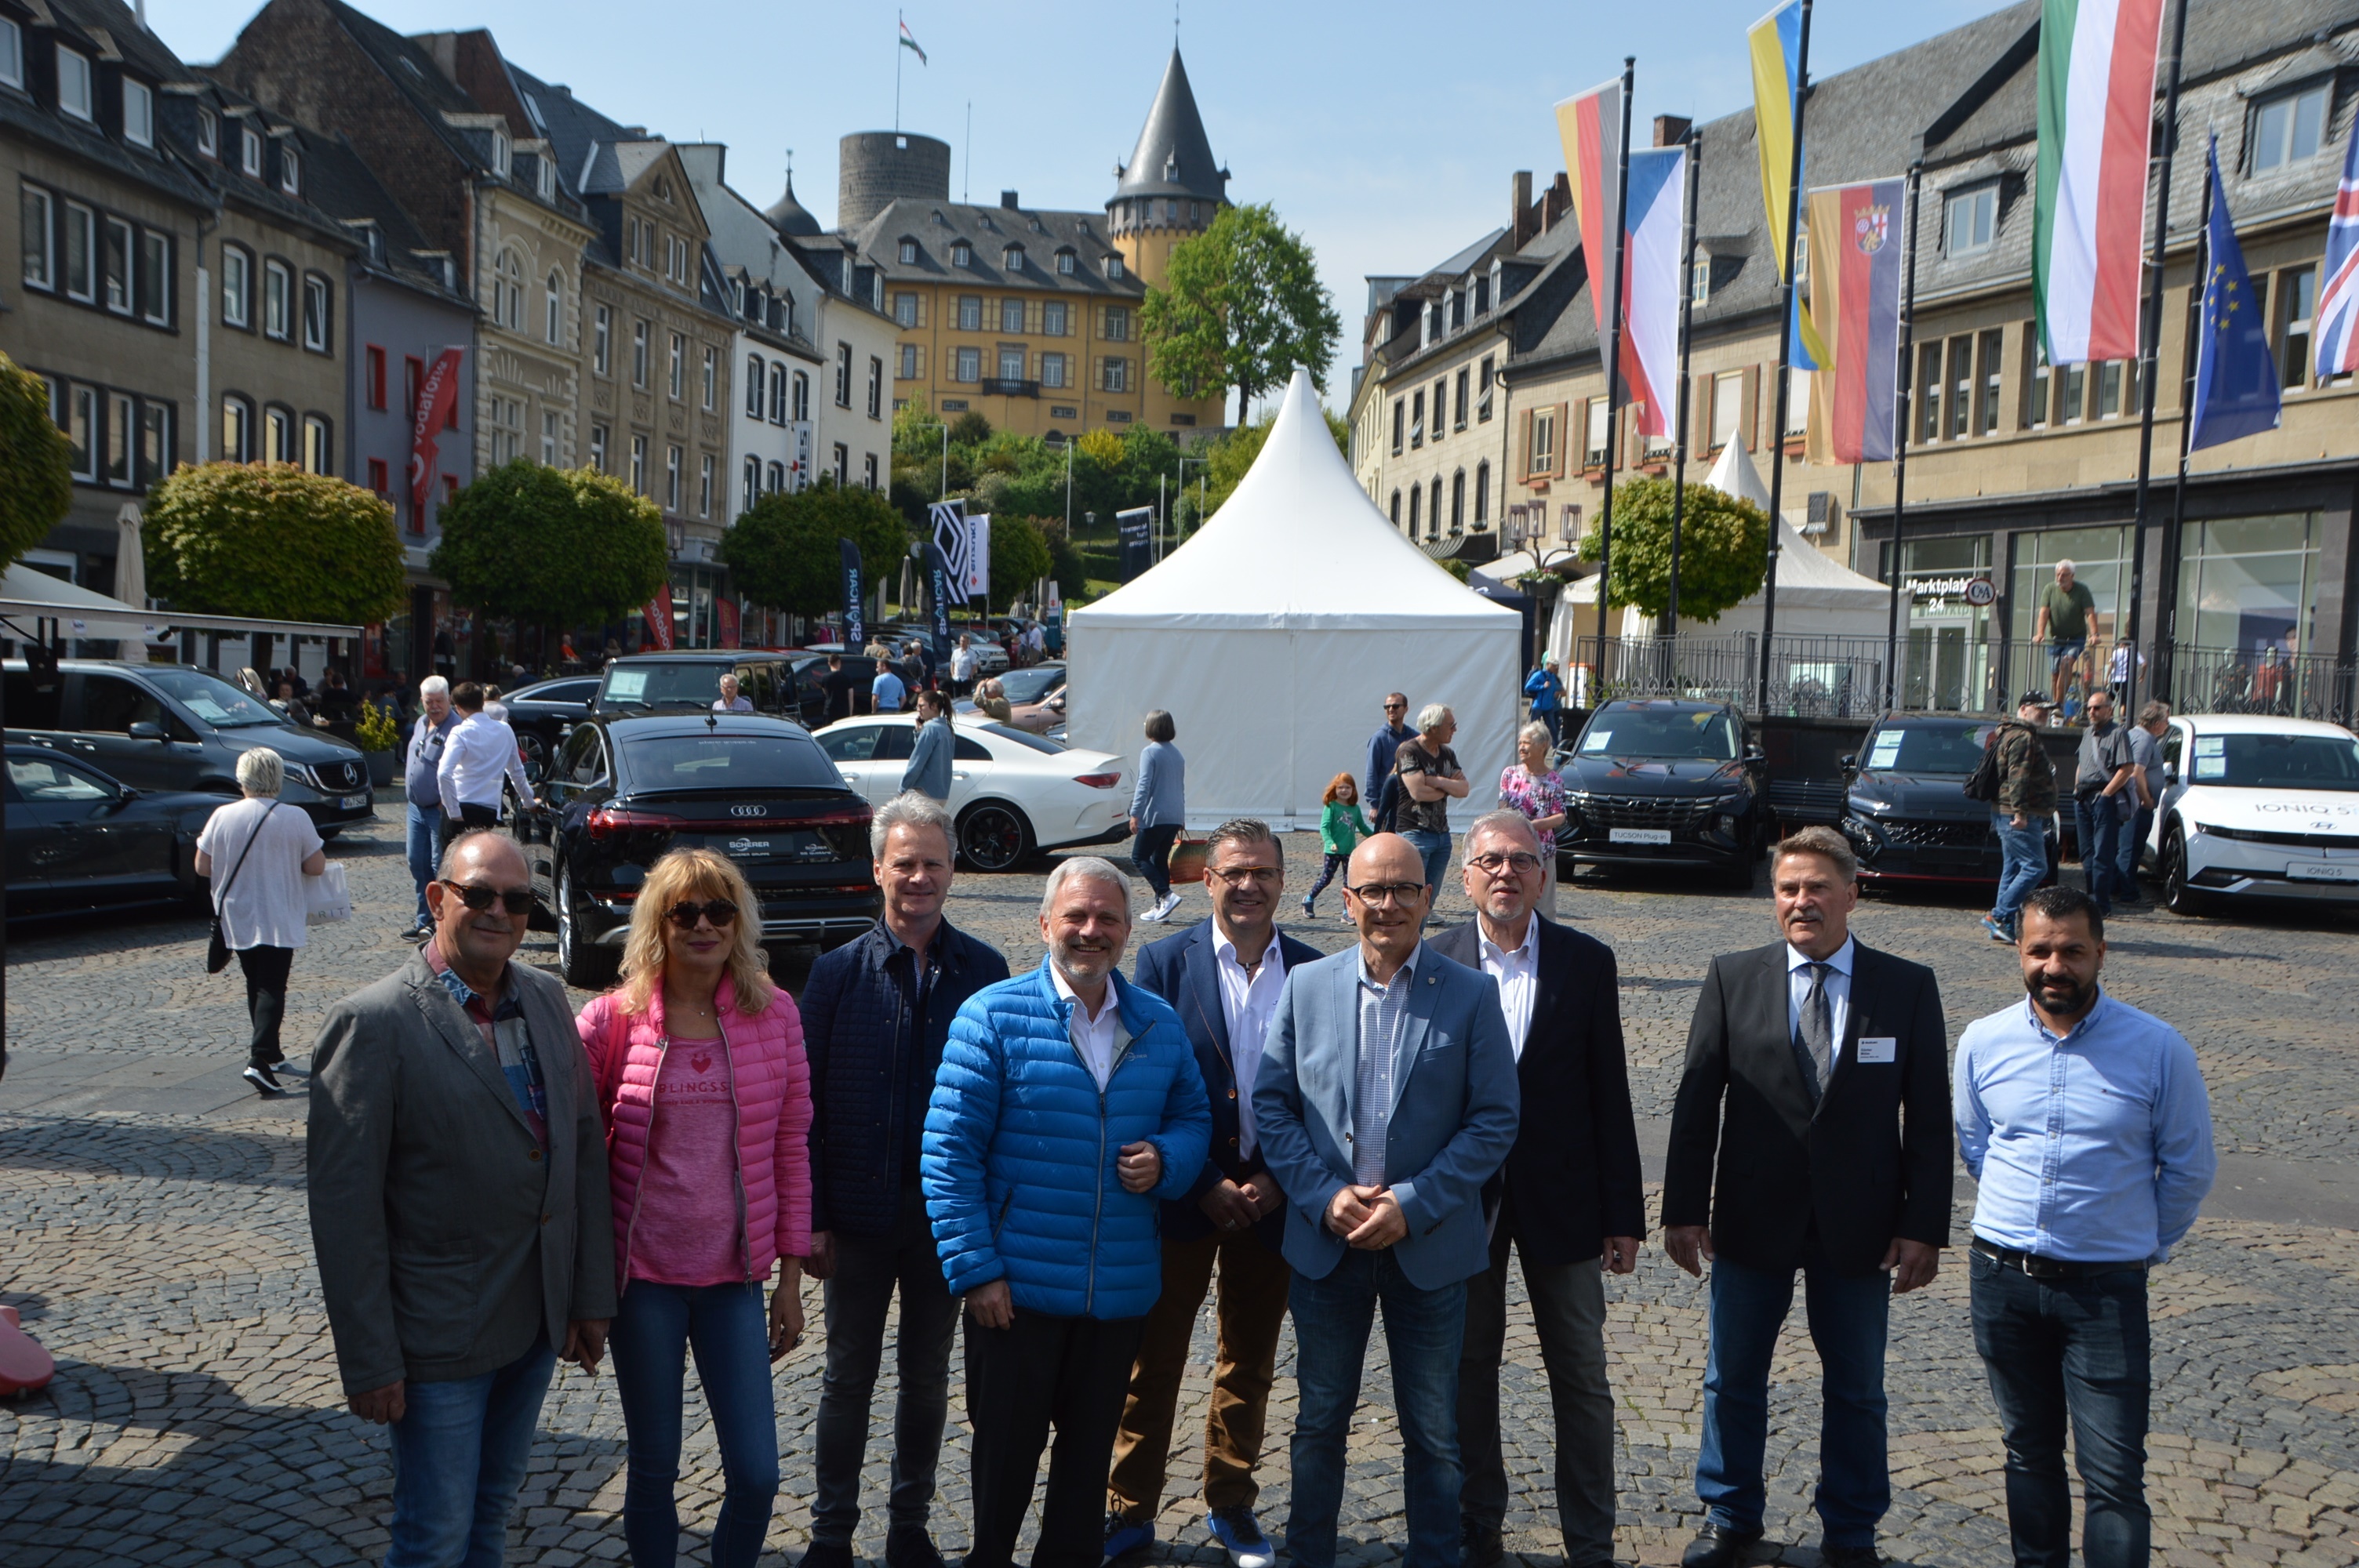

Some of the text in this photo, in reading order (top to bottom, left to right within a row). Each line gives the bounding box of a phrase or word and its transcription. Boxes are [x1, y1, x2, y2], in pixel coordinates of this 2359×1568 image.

[1971, 584, 1990, 599] C&A
[1928, 597, 1945, 612] 24
[2255, 804, 2350, 815] IONIQ 5
[729, 840, 769, 849] SCHERER
[2306, 866, 2343, 877] IONIQ 5
[658, 1081, 728, 1094] BLINGSS
